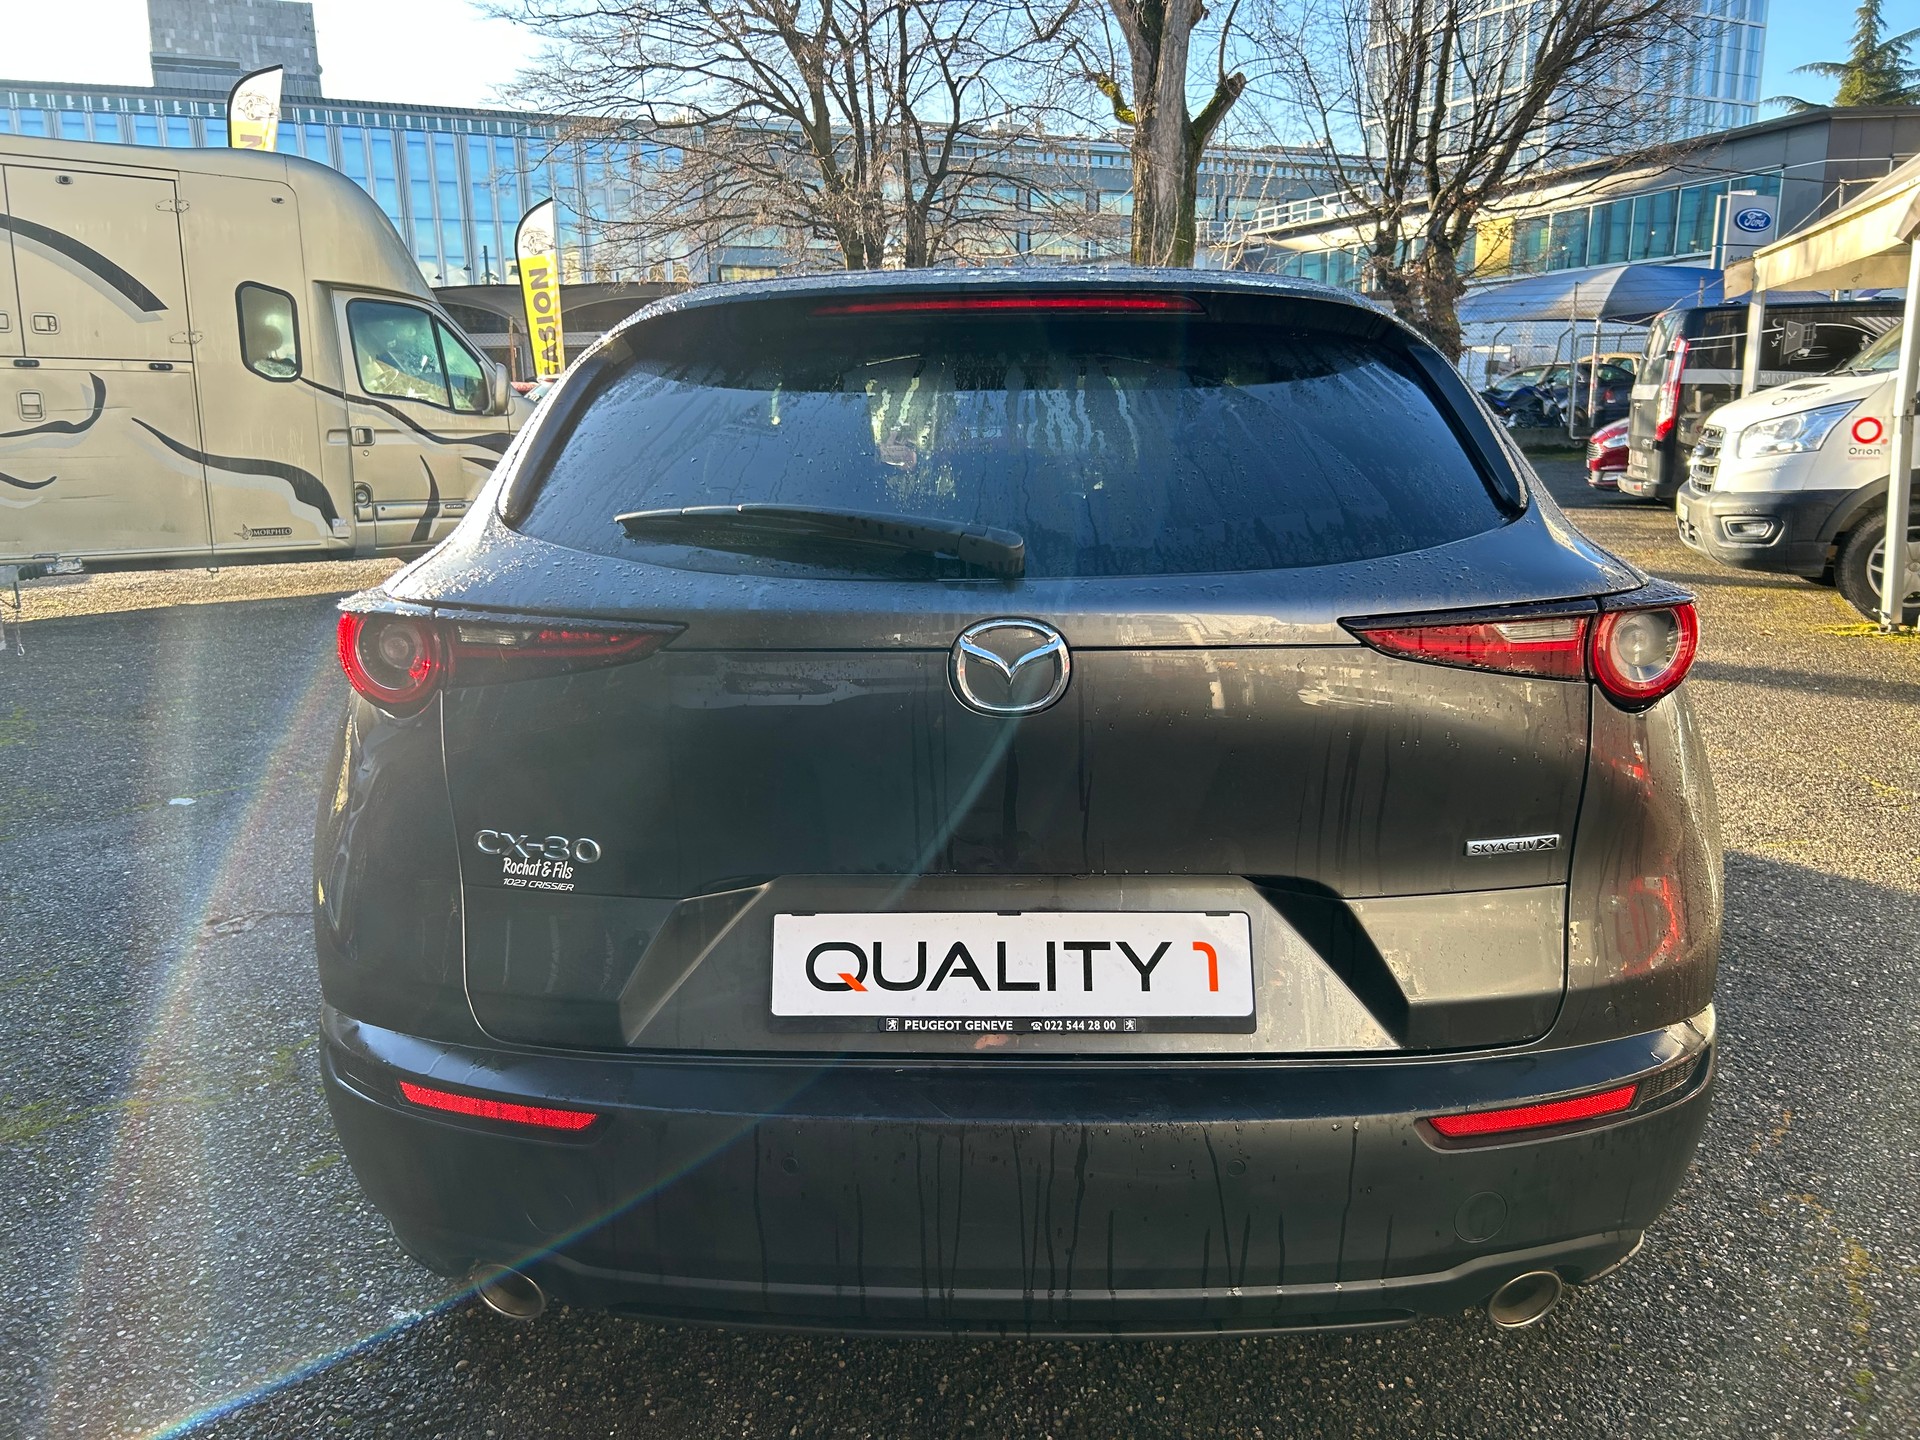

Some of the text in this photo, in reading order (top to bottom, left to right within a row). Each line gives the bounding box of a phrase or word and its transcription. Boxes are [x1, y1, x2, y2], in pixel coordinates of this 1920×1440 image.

[1743, 211, 1768, 228] Ford
[1728, 254, 1748, 263] Aut
[253, 528, 292, 536] MORPHEO
[473, 829, 602, 864] CX-30
[502, 857, 574, 880] Rochat & Fils
[503, 878, 574, 891] 1023 CRISSIER
[805, 941, 1220, 992] QUALITY 1
[904, 1020, 1117, 1031] PEUGEOT GENEVE 022 544 28 00
